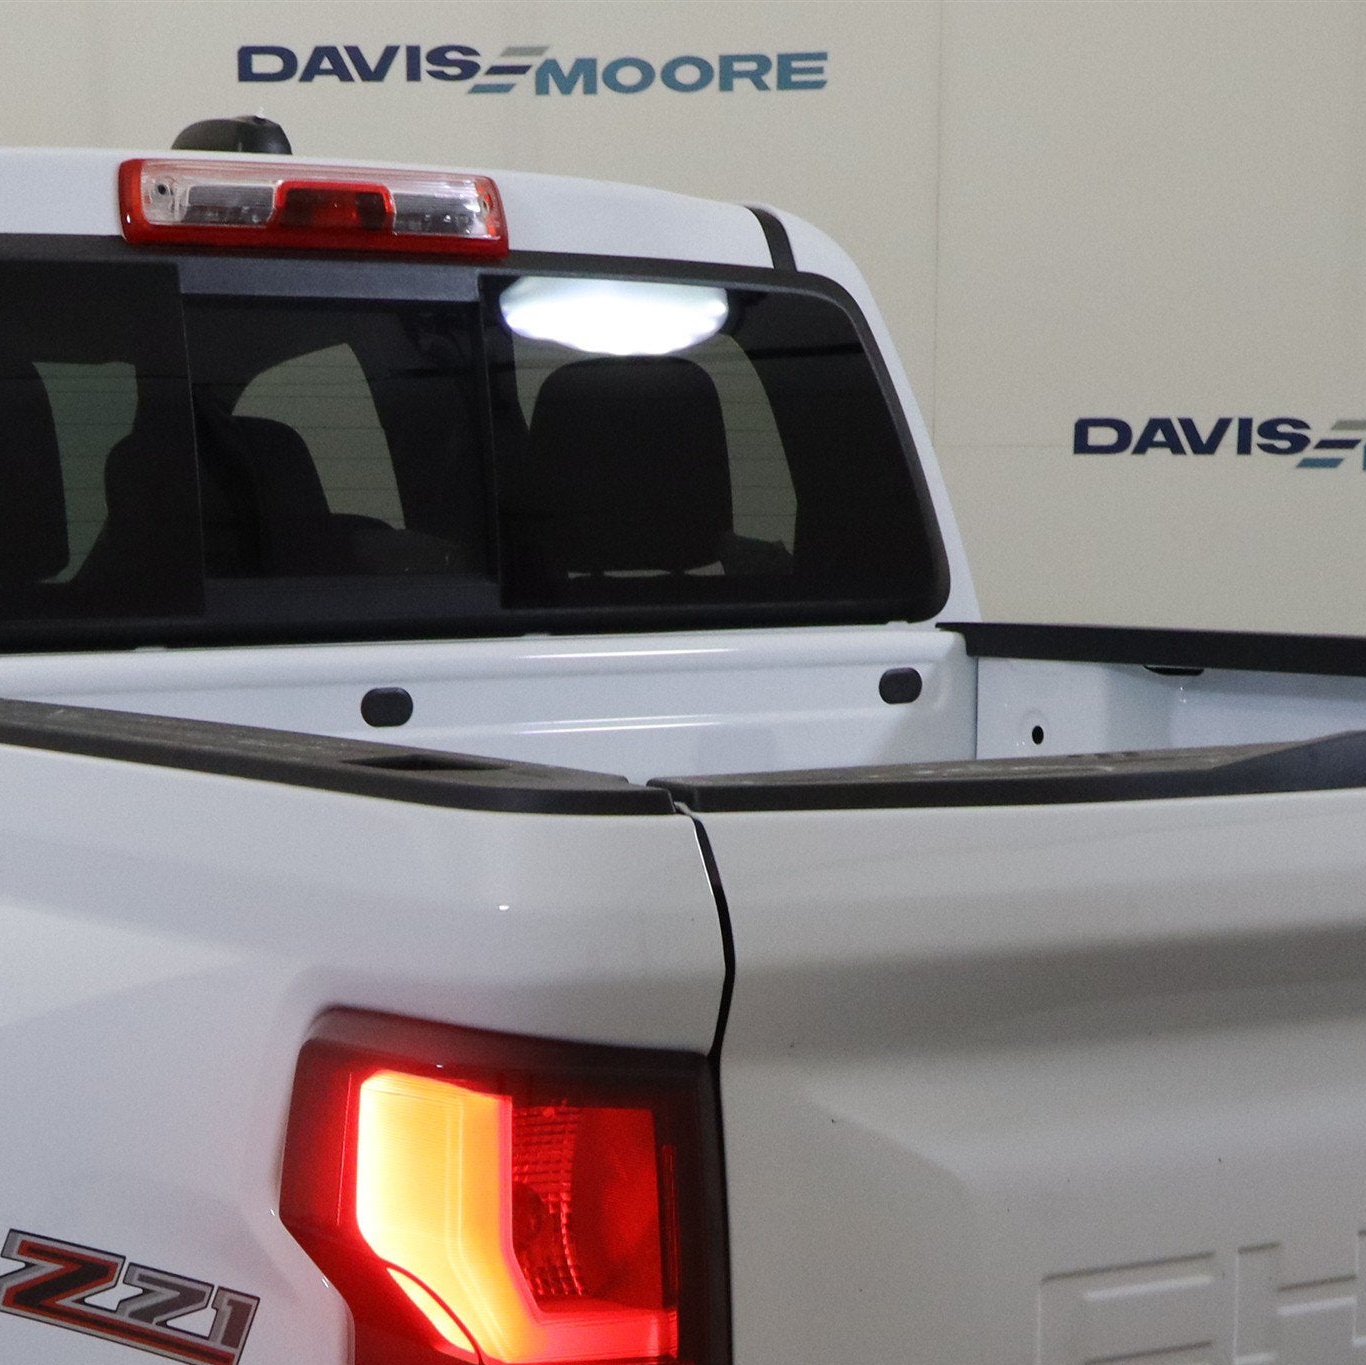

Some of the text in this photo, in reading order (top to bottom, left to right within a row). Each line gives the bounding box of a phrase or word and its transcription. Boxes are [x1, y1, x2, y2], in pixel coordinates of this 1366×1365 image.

[237, 45, 829, 96] DAVIS MOORE
[1073, 417, 1312, 455] DAVIS
